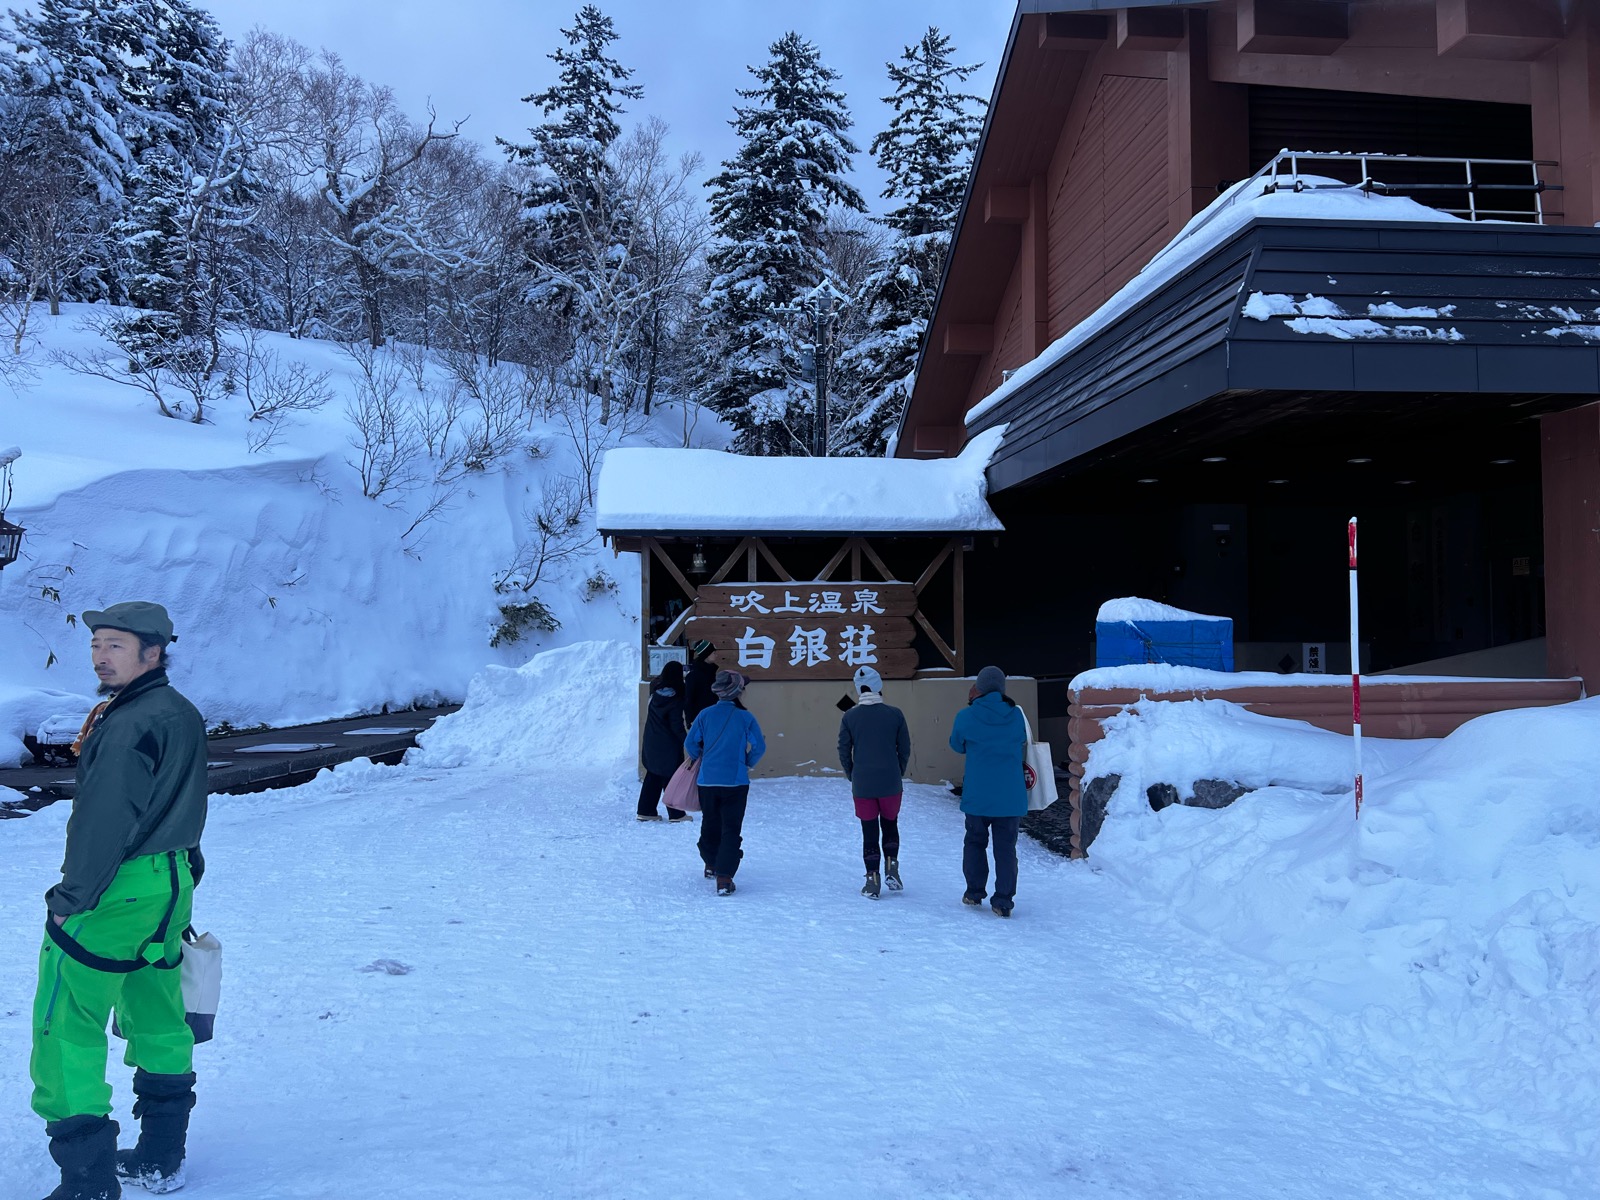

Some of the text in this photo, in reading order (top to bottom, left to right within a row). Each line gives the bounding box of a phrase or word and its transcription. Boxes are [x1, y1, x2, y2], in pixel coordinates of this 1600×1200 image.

[730, 589, 885, 614] 吹上温泉
[735, 625, 878, 669] 白銀荘
